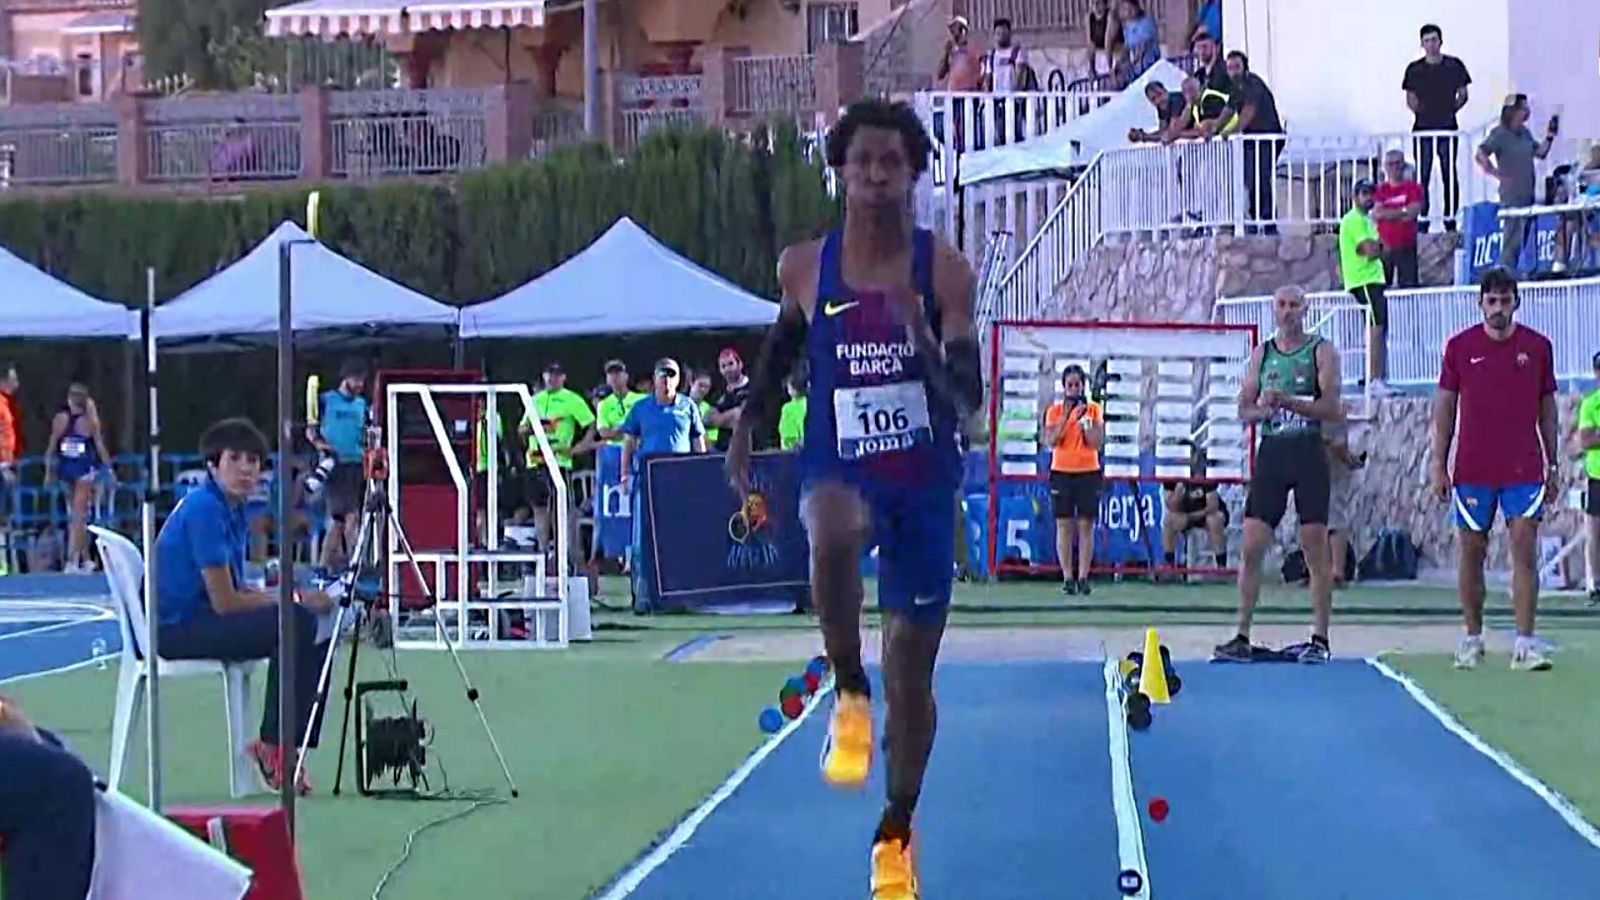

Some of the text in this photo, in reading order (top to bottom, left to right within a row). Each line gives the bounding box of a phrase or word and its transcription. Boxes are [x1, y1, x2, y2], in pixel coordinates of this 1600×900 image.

[850, 358, 903, 376] BARÇA
[858, 407, 909, 434] 106
[1006, 519, 1032, 560] 5
